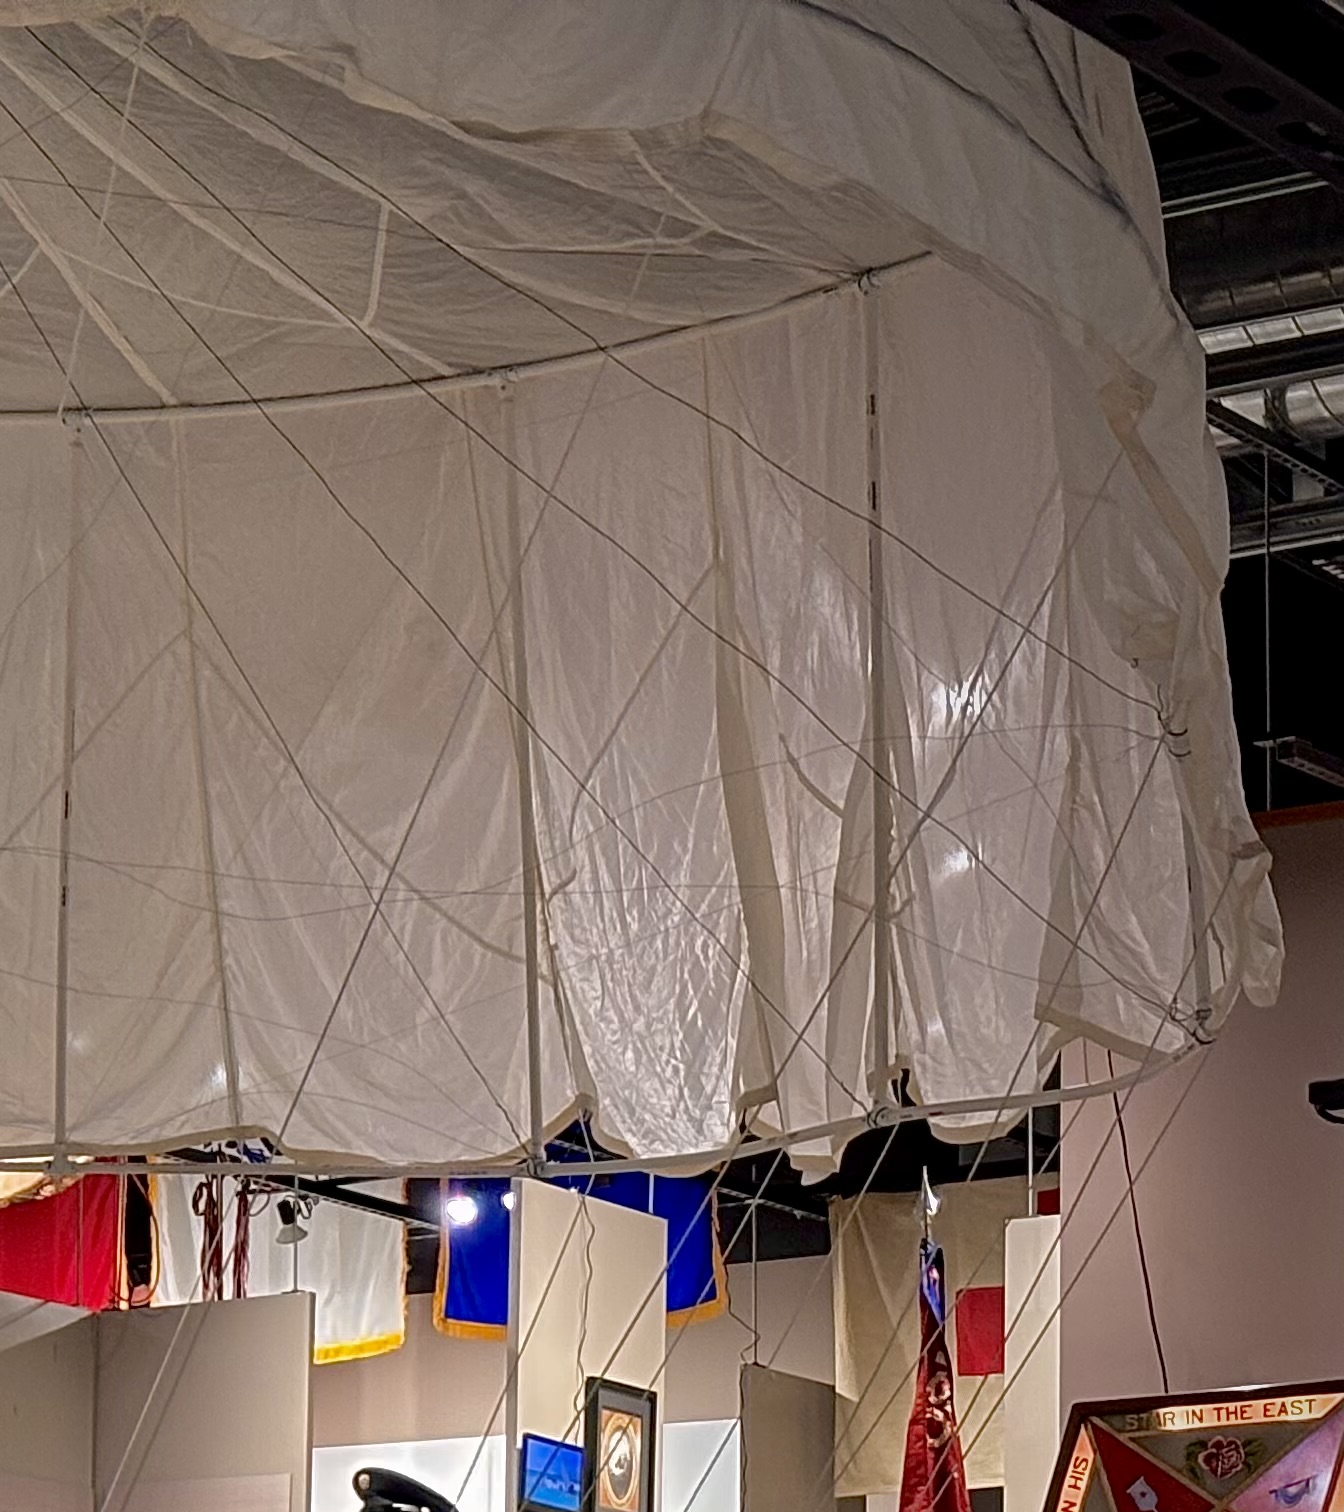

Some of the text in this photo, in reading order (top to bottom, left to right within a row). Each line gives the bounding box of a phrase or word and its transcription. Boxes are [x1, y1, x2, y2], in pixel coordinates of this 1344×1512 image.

[1125, 1398, 1318, 1431] STAR IN THE EAST
[1067, 1455, 1089, 1491] HIS
